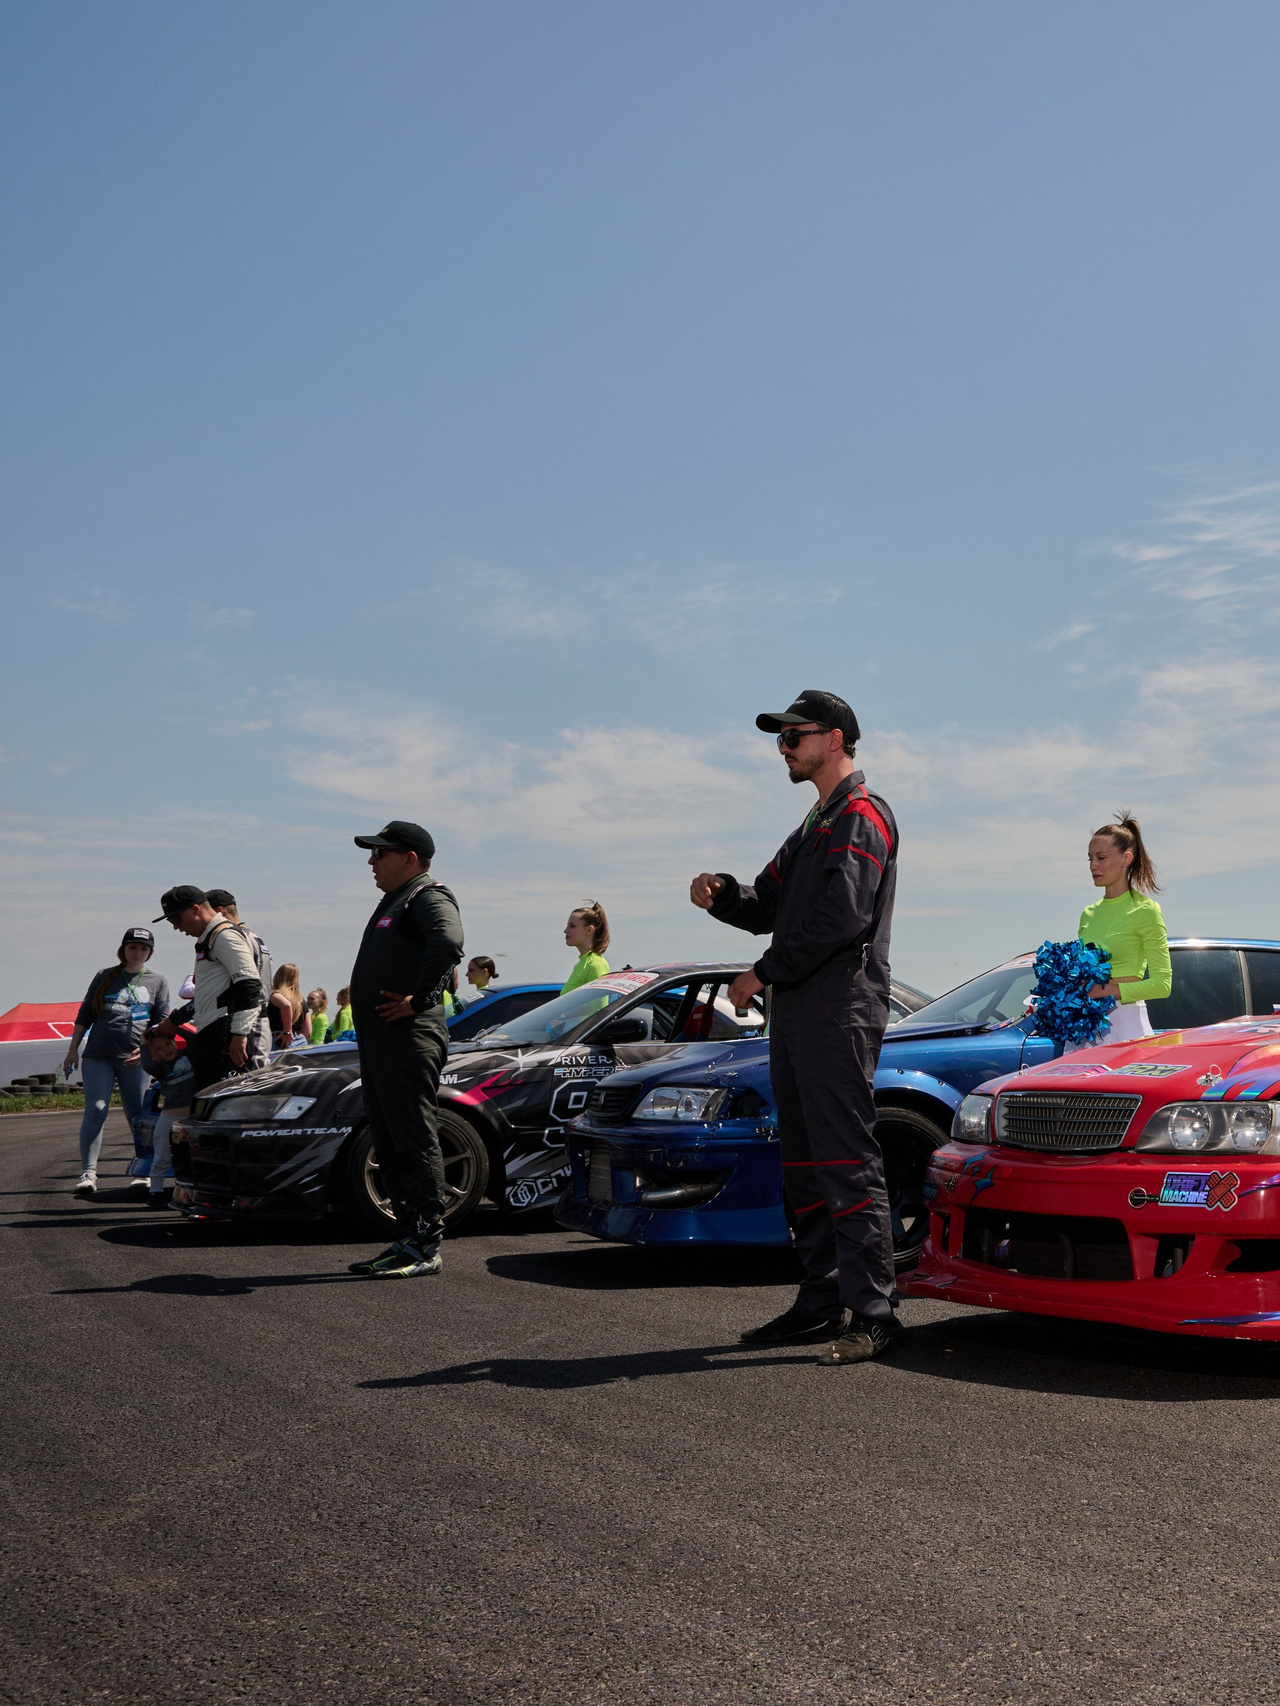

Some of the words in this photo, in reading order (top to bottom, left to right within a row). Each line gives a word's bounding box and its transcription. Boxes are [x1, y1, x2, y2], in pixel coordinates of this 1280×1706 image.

[555, 1066, 614, 1078] HYPER
[1165, 1174, 1210, 1191] DRIFT
[1162, 1190, 1209, 1204] MACHINE
